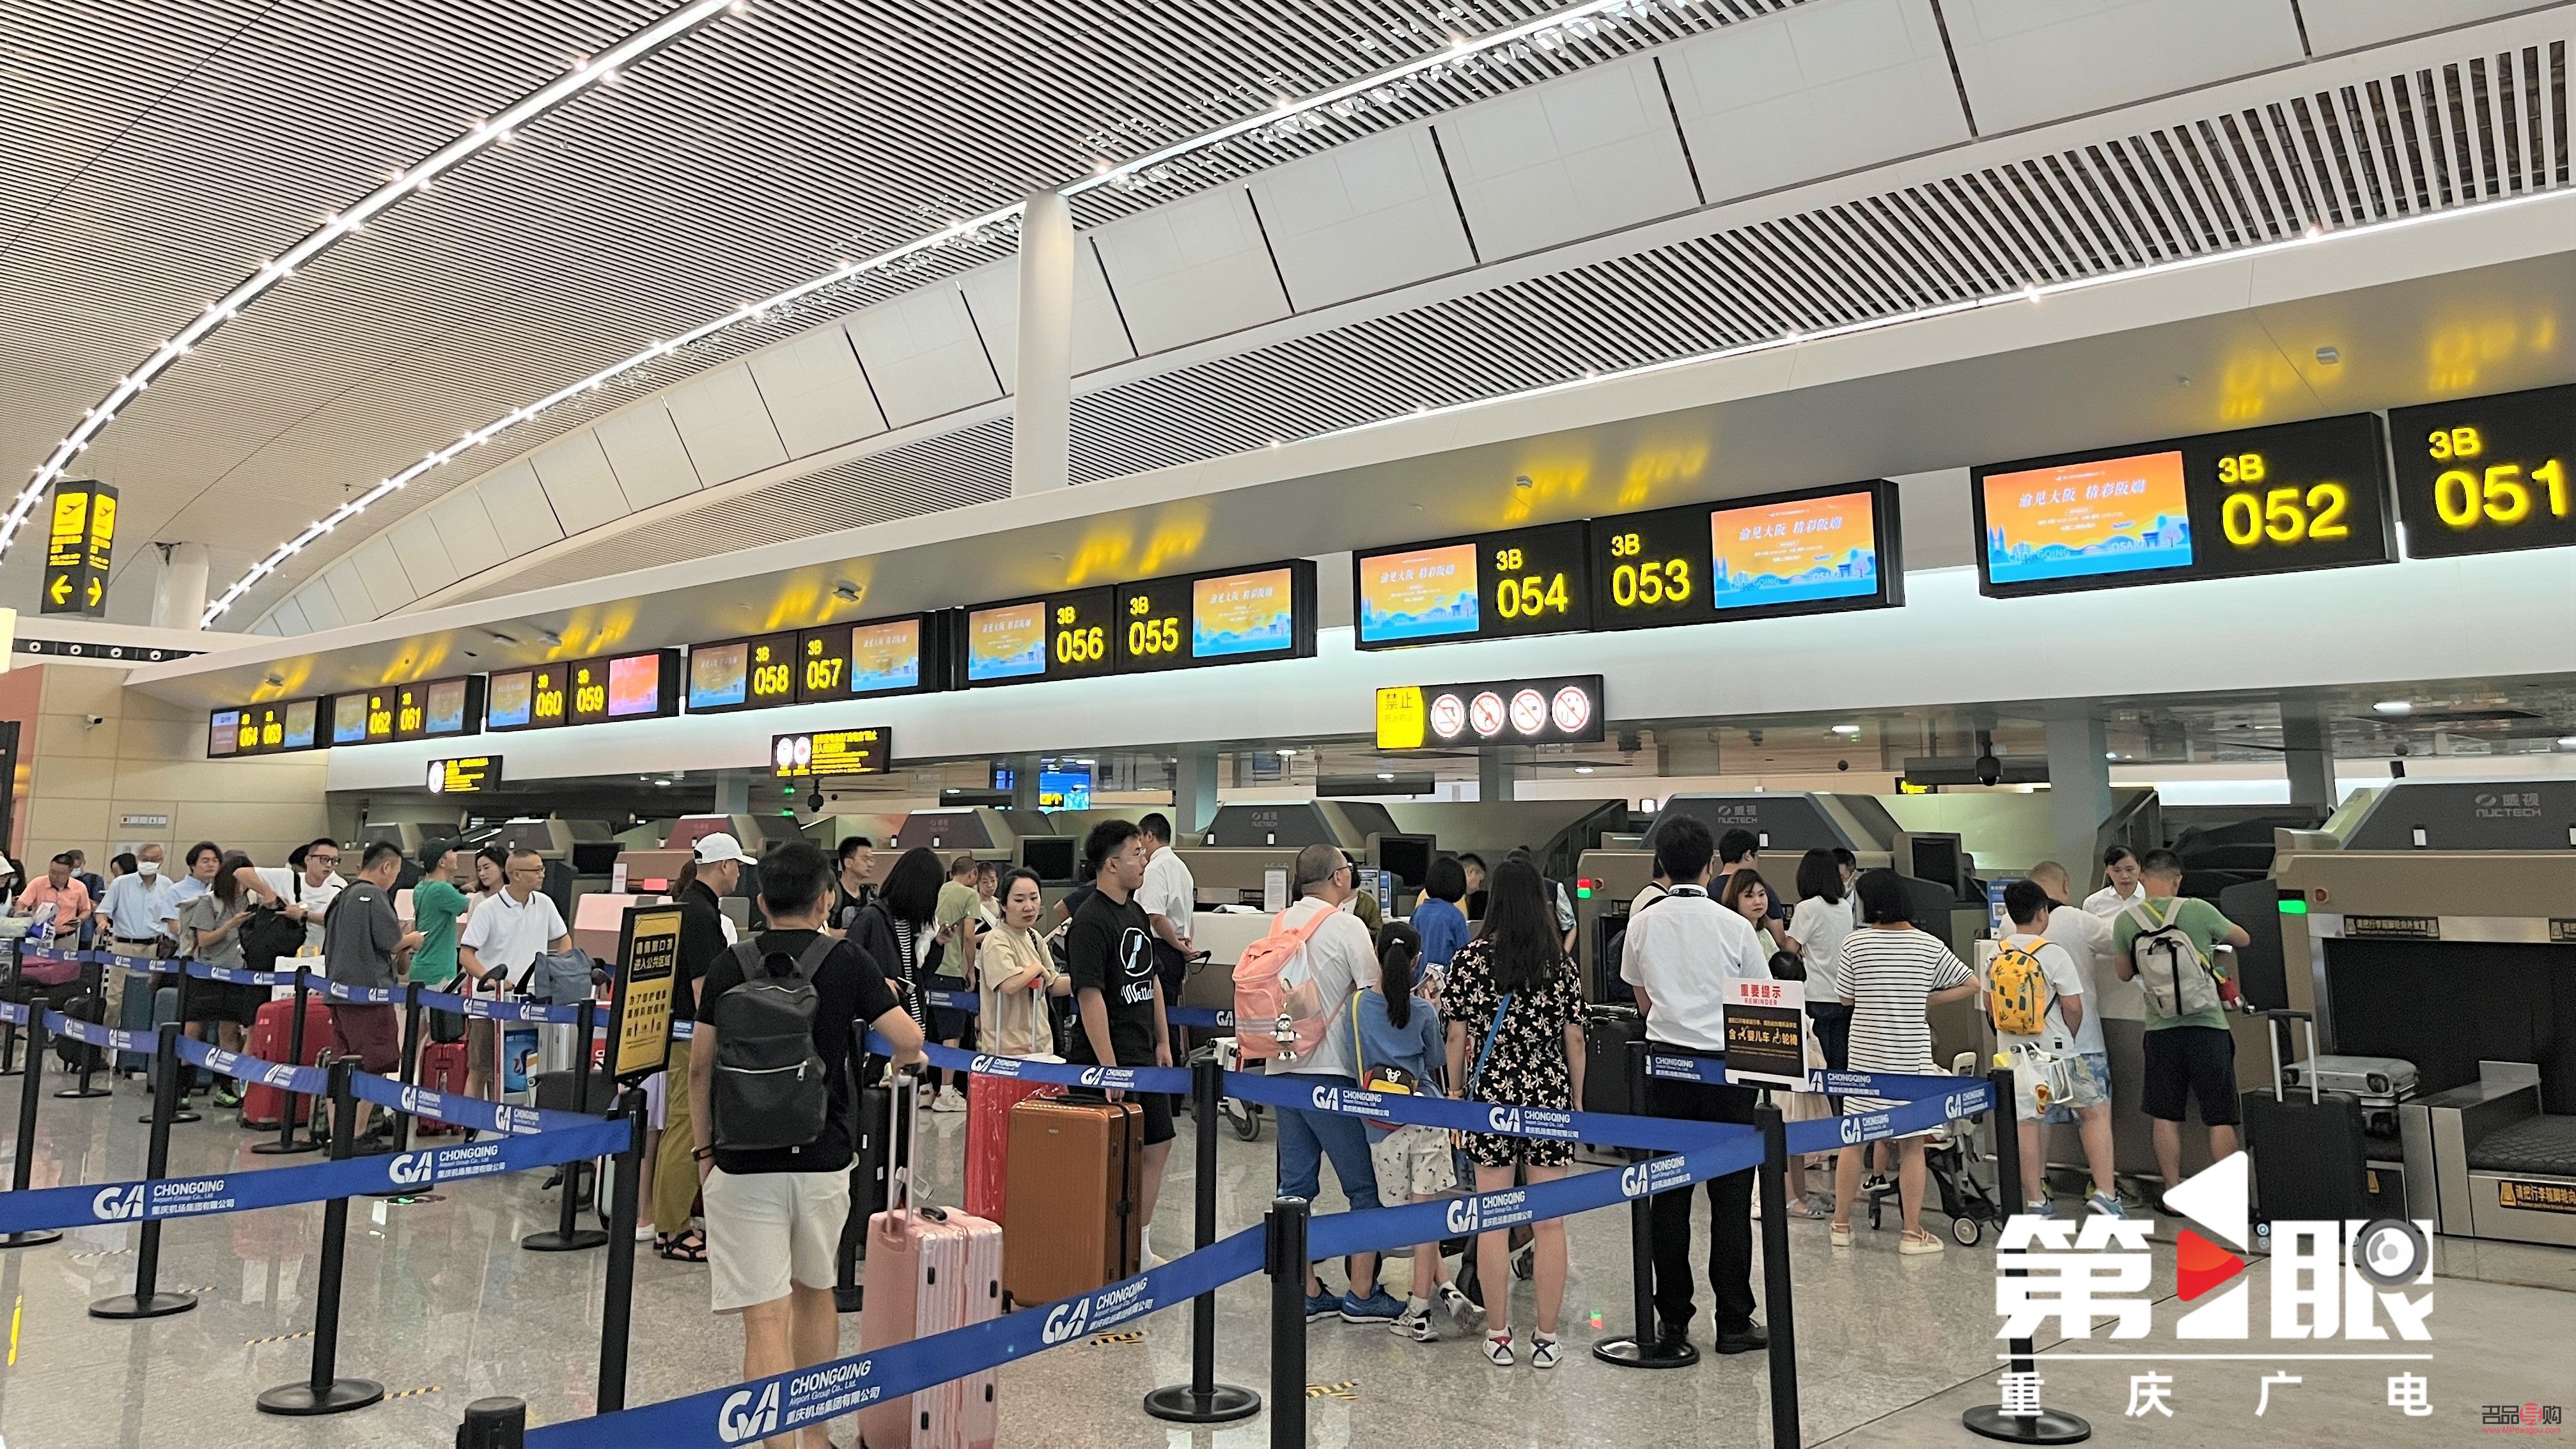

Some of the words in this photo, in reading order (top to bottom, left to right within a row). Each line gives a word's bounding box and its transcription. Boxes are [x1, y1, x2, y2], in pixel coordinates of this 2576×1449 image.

[2430, 427, 2480, 458] 3B
[2219, 453, 2265, 484] 3B
[2433, 458, 2566, 526] 051
[2219, 482, 2348, 545] 052
[1612, 533, 1641, 557] 3B
[1497, 549, 1522, 571] 3B
[1612, 559, 1690, 606] 053
[1130, 597, 1150, 616] 3B
[1496, 573, 1568, 618] 054
[1057, 606, 1076, 625] 3B
[1056, 627, 1104, 663] 056
[1128, 618, 1178, 655] 055
[754, 664, 789, 695] 058
[806, 658, 843, 690] 057
[535, 690, 563, 717] 060
[576, 685, 605, 713] 059
[1386, 692, 1413, 710] 禁止
[368, 711, 391, 734] 062
[400, 707, 421, 731] 061
[2476, 808, 2541, 817] NUCTECH
[1740, 984, 1781, 998] 重要提示
[1744, 998, 1777, 1006] REMINDER
[1827, 1073, 1871, 1083] CHONGQING
[1343, 1090, 1382, 1102] CHONGQING
[1524, 1110, 1570, 1124] CHONGQING
[439, 1145, 498, 1162] CHONGQING
[153, 1180, 224, 1196] CHONGQING
[1482, 1190, 1526, 1209] CHONGQING
[1096, 1277, 1148, 1310] CHONGQING
[790, 1359, 871, 1397] CHONGQING
[785, 1386, 880, 1425] 重庆机场集团有限公司
[789, 1393, 810, 1407] Airport
[811, 1386, 831, 1400] Group
